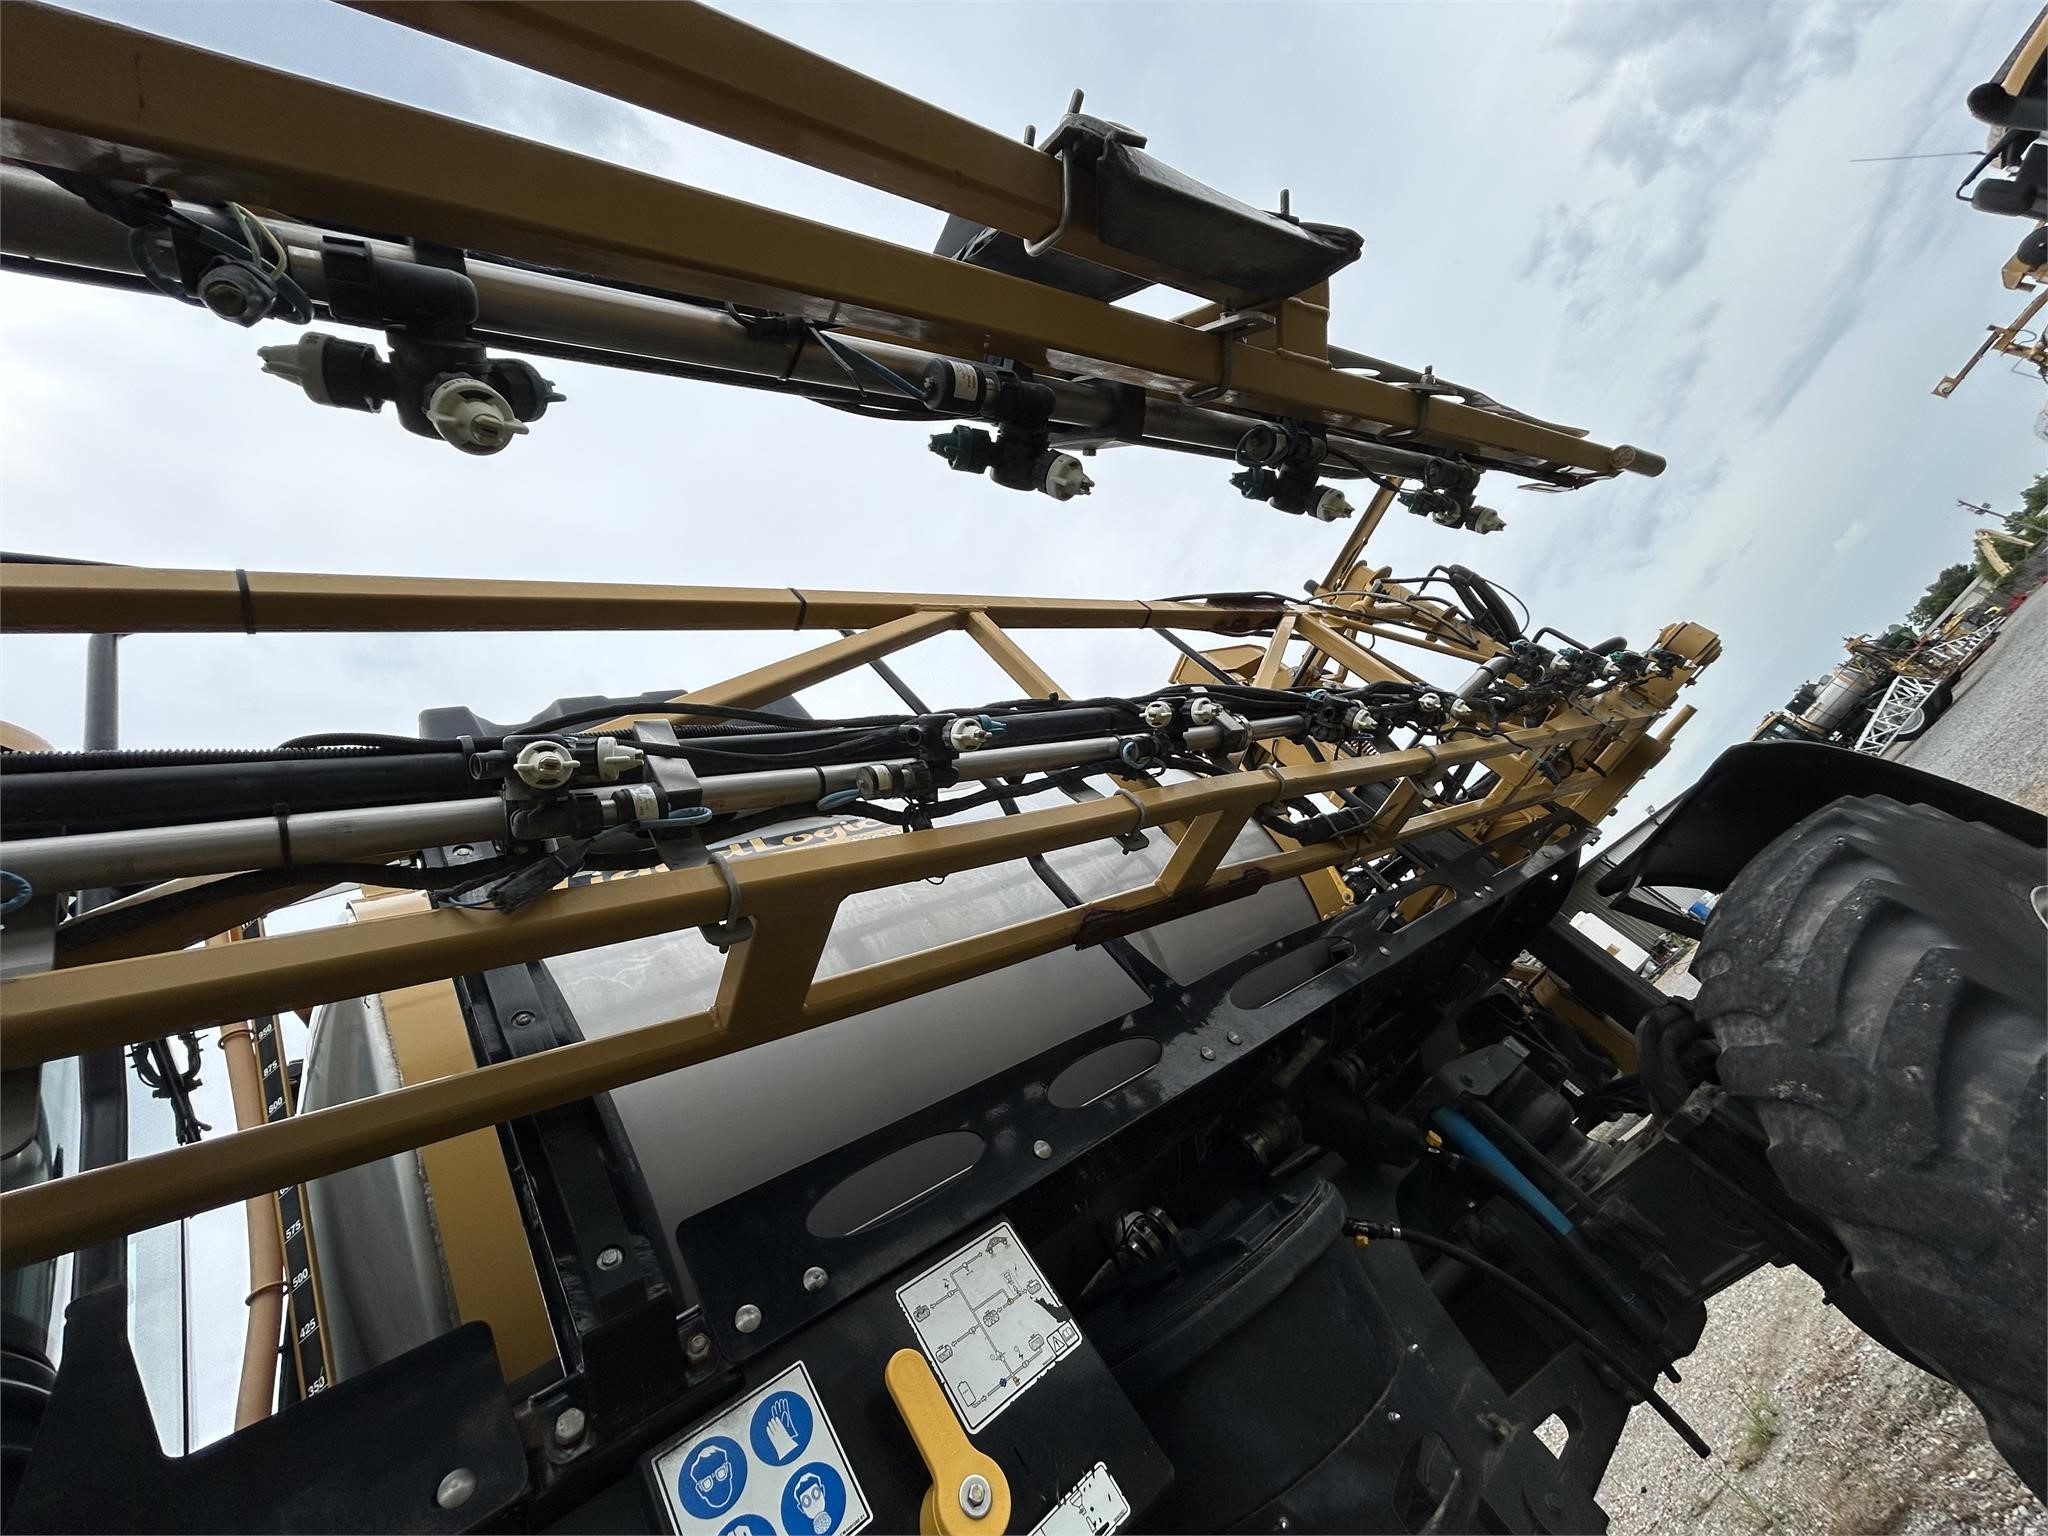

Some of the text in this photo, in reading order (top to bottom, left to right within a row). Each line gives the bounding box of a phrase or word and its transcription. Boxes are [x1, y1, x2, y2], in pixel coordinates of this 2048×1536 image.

[258, 1024, 272, 1040] 950
[263, 1060, 278, 1077] 875
[268, 1097, 283, 1113] 800
[285, 1220, 301, 1239] 575
[292, 1268, 309, 1288] 500
[300, 1317, 316, 1338] 425
[307, 1375, 325, 1398] 350
